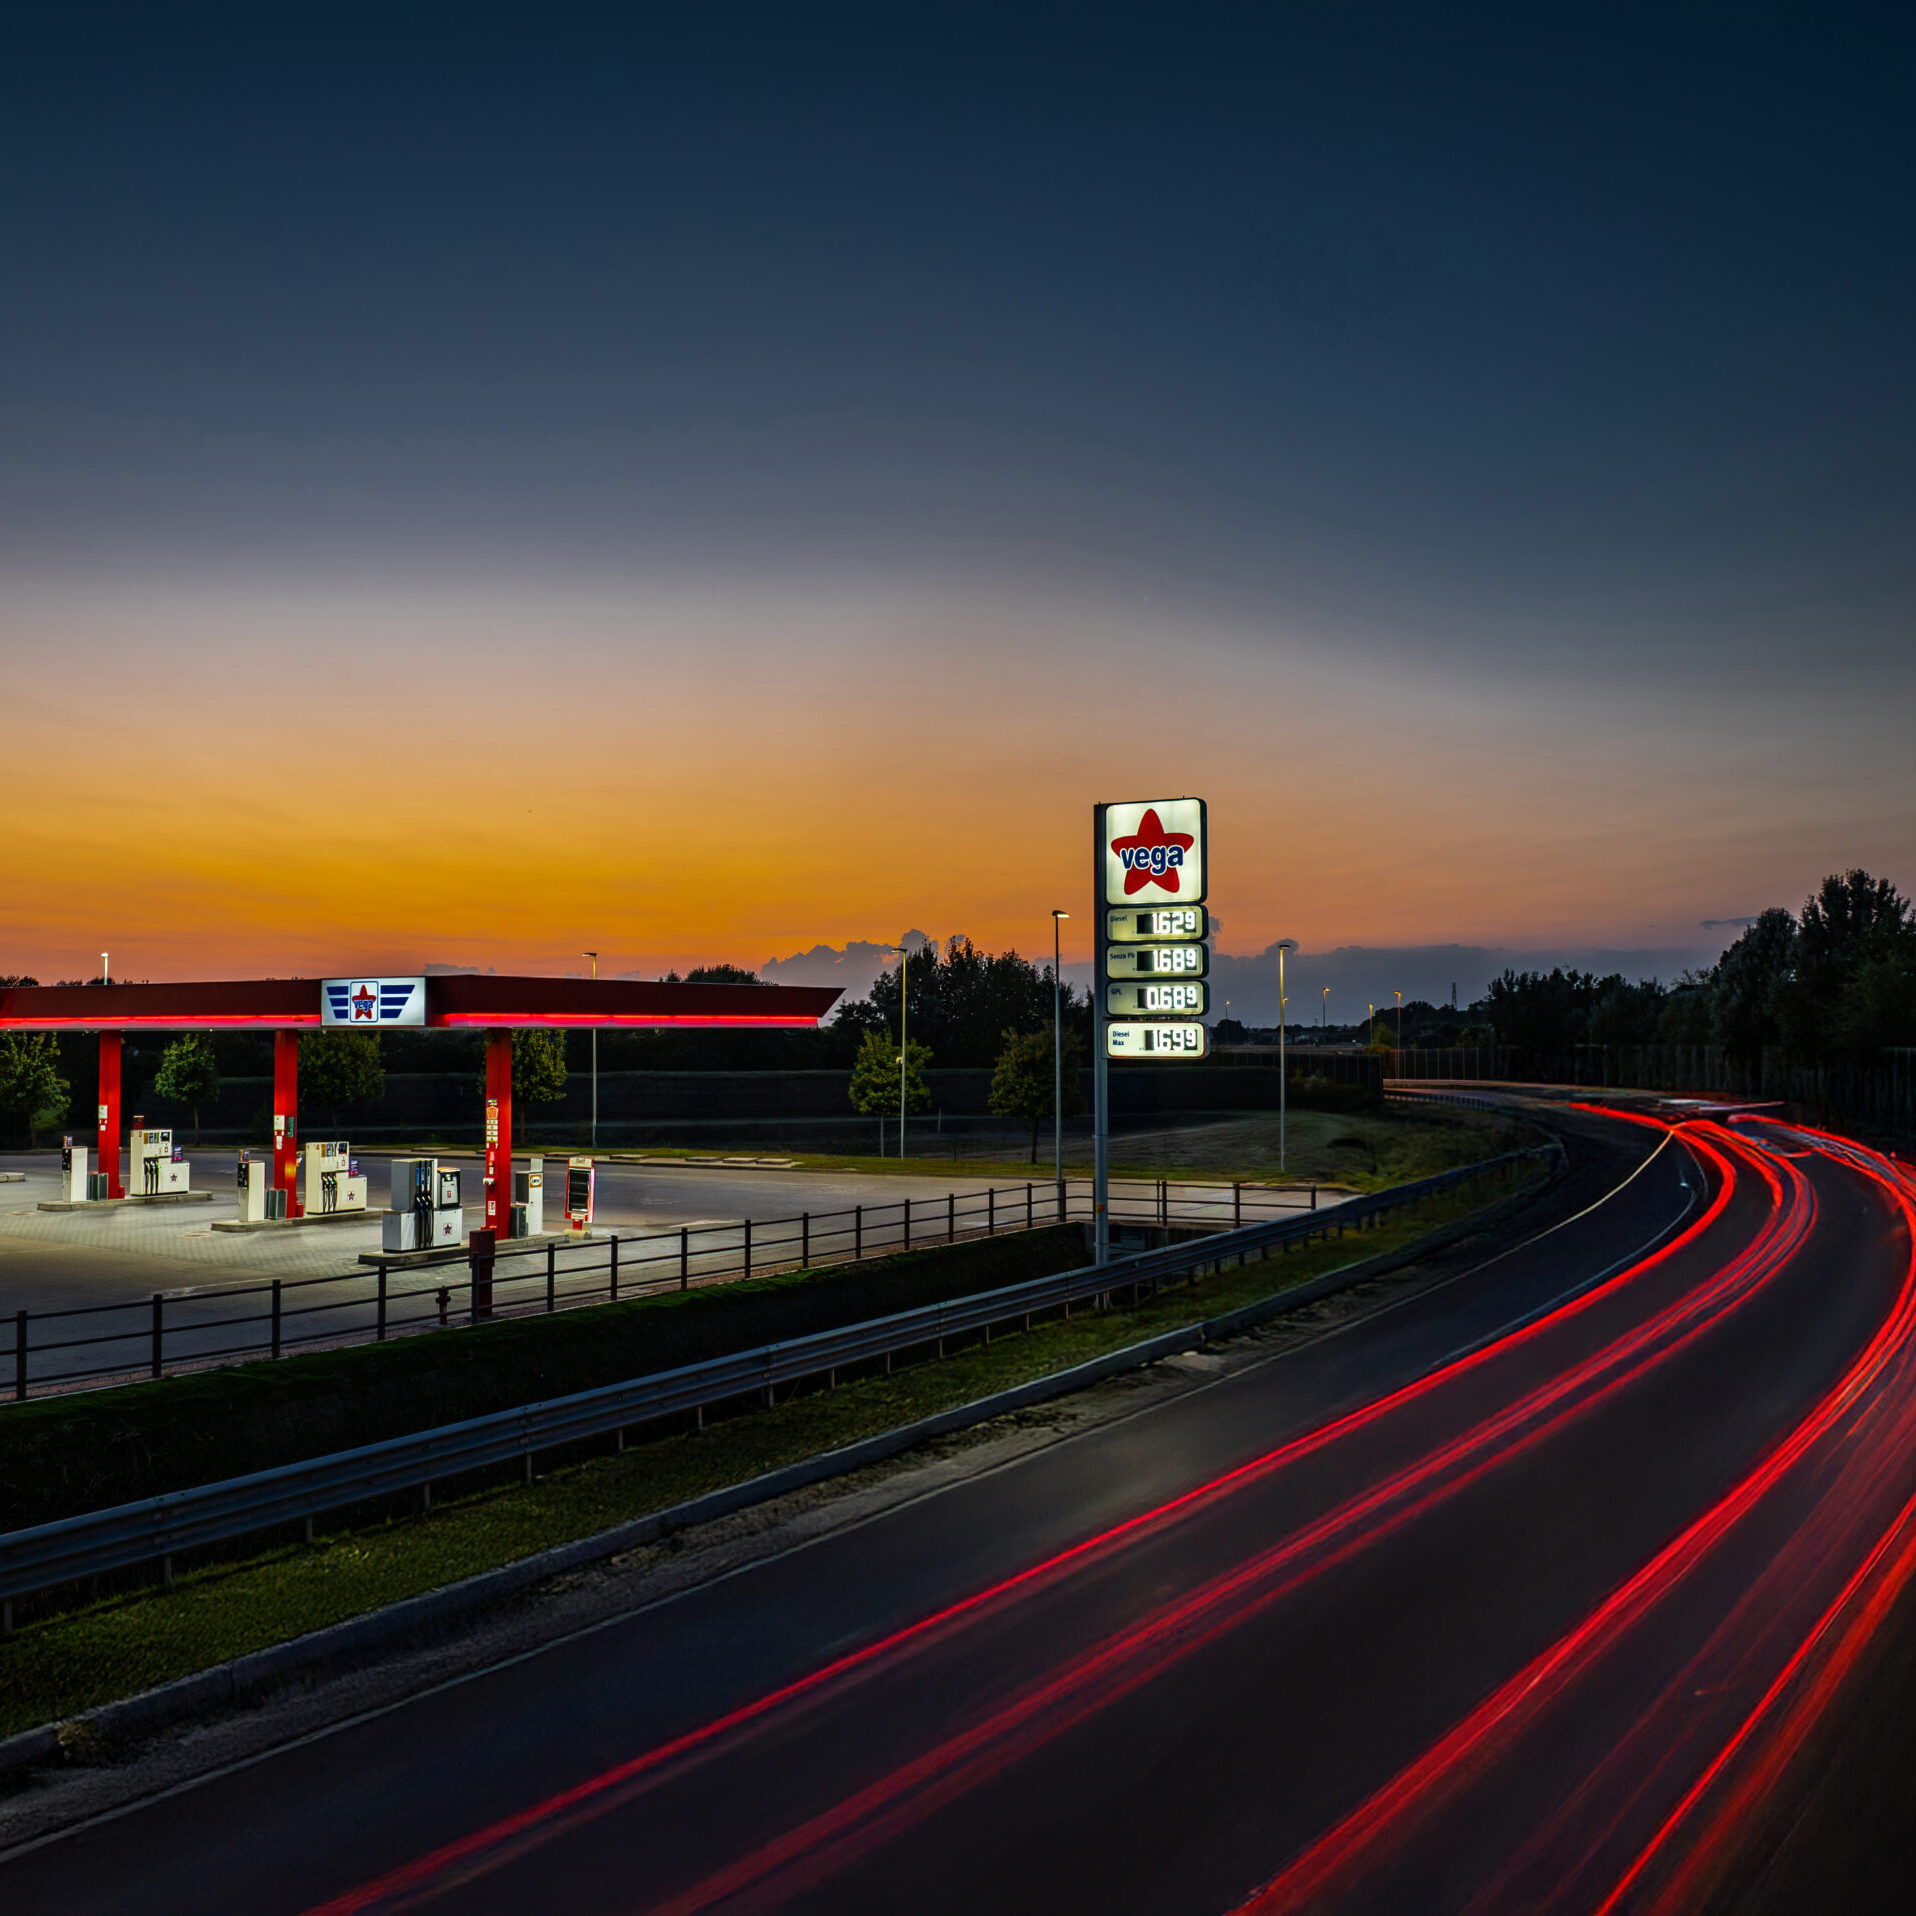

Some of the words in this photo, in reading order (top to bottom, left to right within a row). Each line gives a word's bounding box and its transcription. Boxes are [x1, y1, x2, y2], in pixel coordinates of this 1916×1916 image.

[1120, 845, 1184, 875] vega
[1110, 915, 1128, 923] Diesel
[1111, 988, 1122, 996] GPL
[353, 999, 373, 1012] vega
